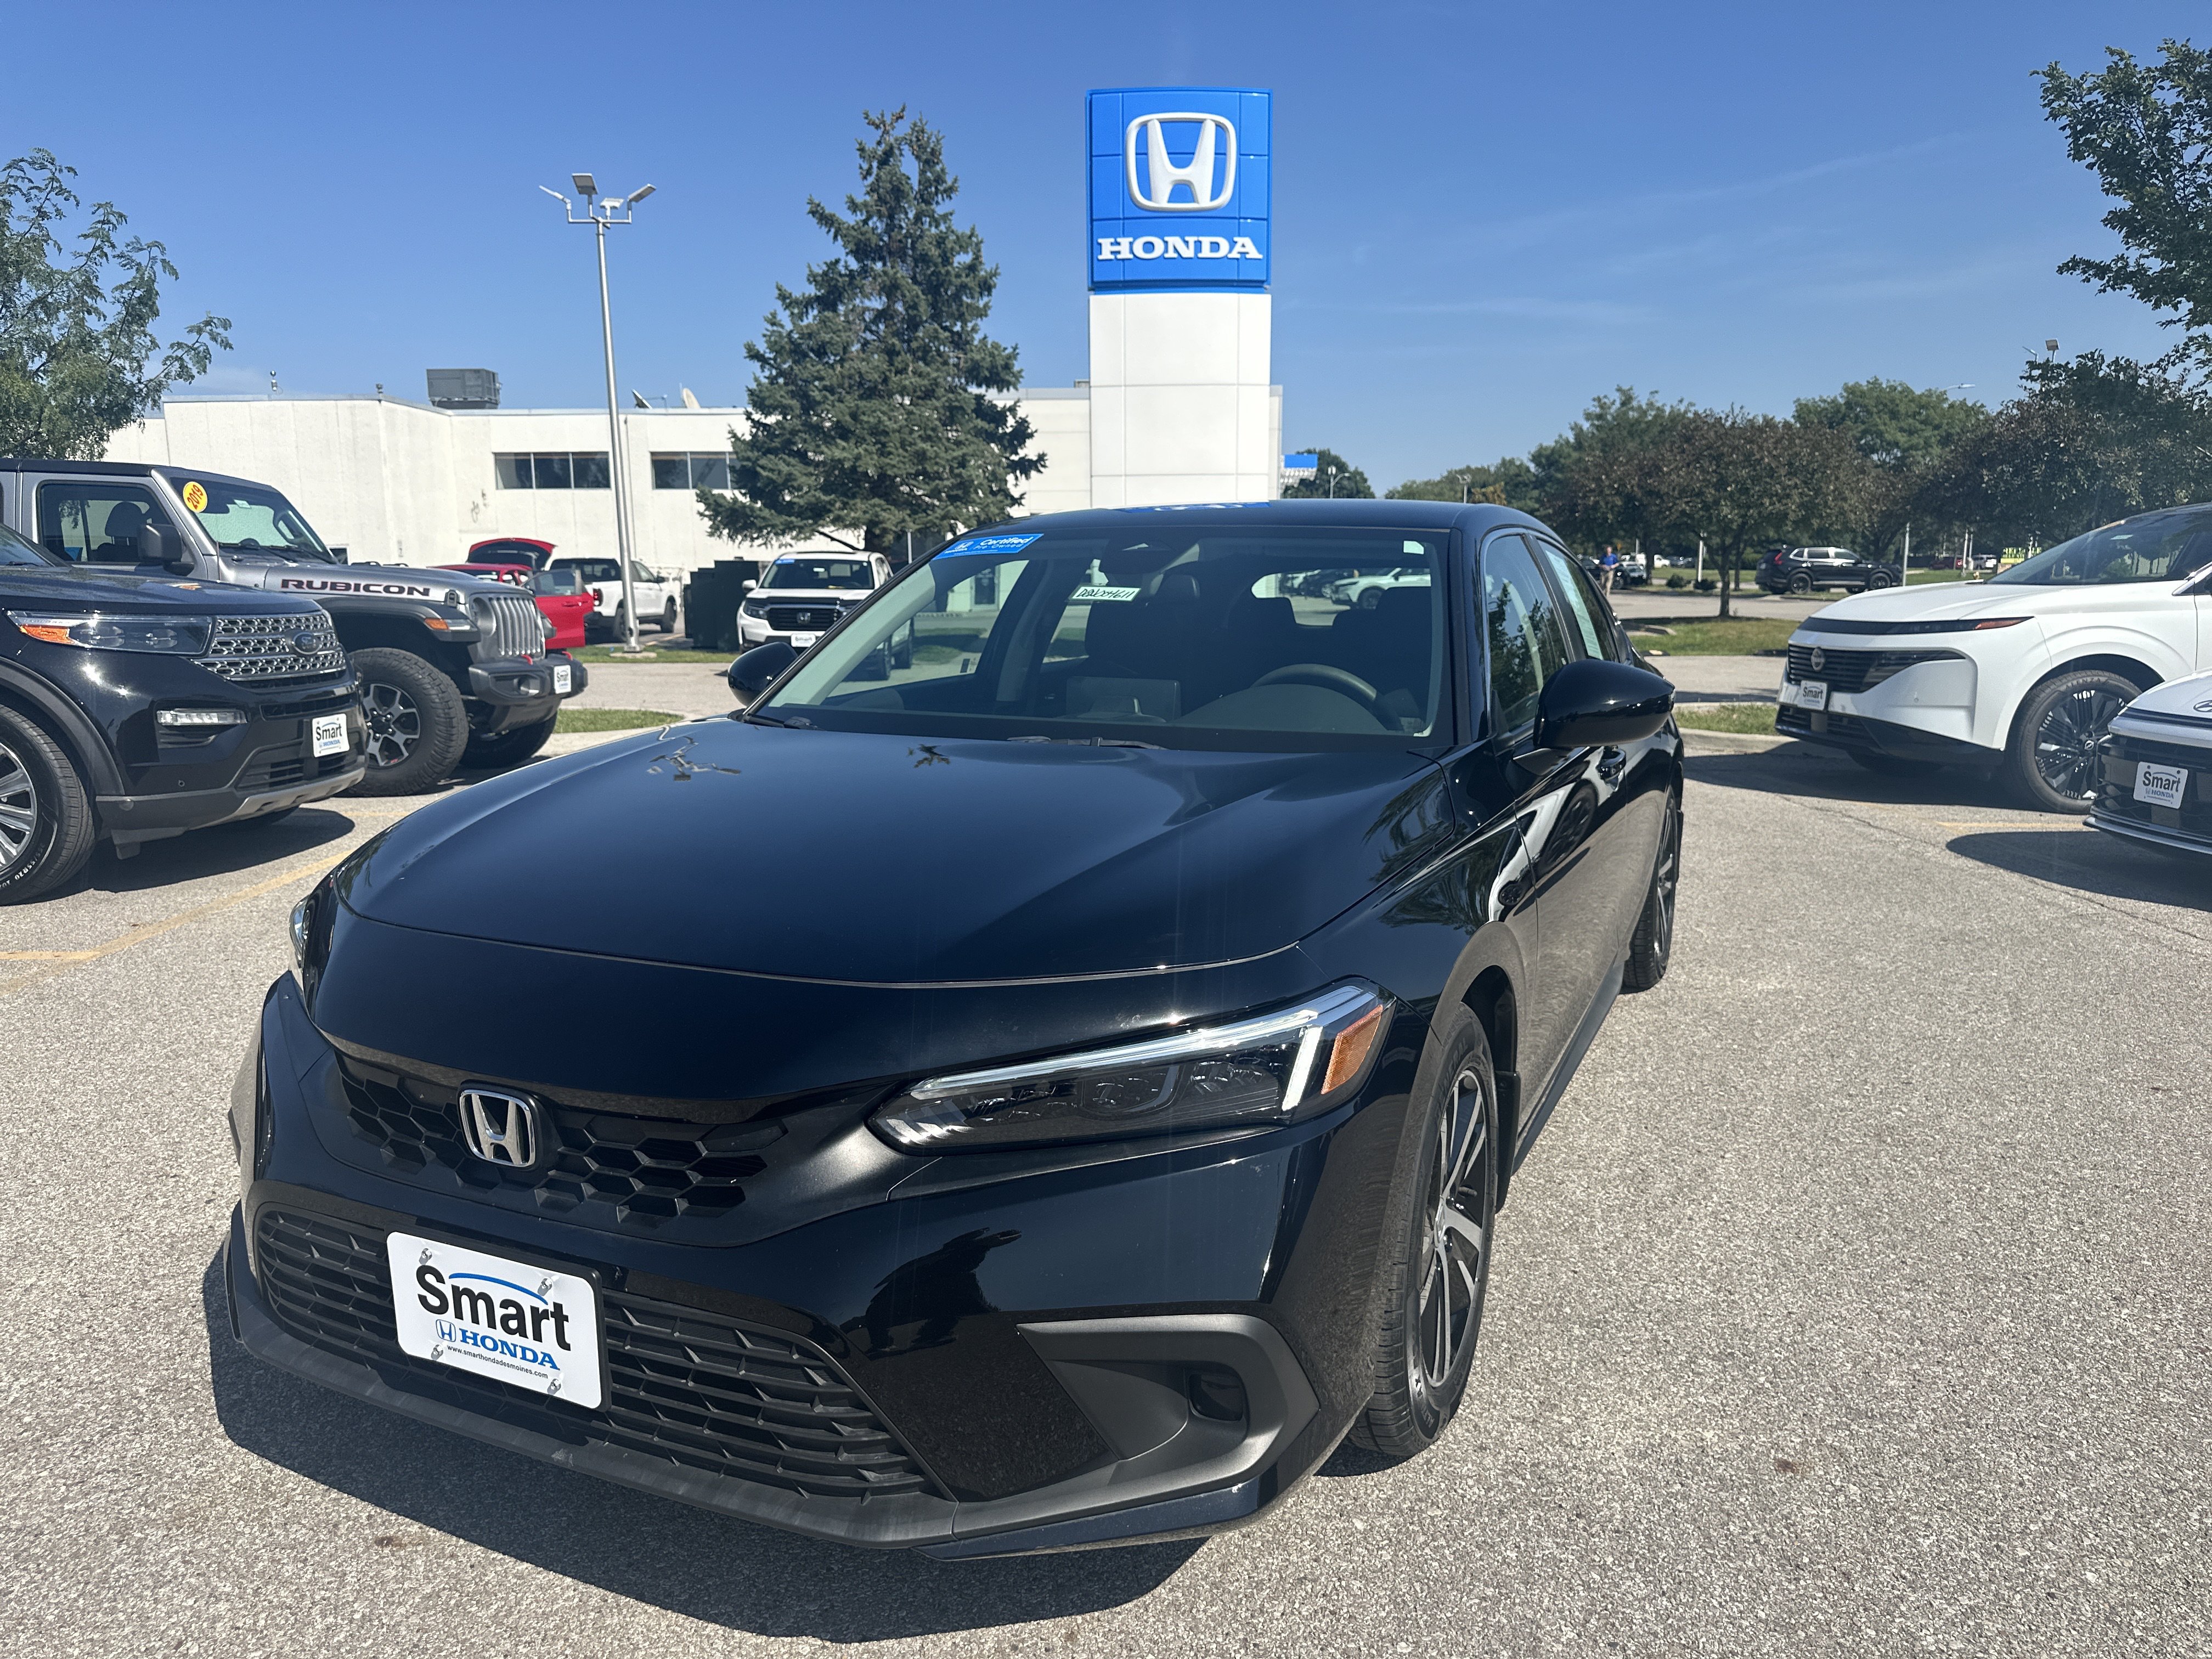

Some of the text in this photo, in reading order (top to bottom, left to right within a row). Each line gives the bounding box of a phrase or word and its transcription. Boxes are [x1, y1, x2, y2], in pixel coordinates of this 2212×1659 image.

[1097, 236, 1263, 259] HONDA
[187, 484, 204, 510] 2019
[980, 537, 1034, 545] Certified
[280, 579, 430, 596] RUBICON
[1803, 686, 1823, 699] Smart
[316, 724, 342, 741] Smart
[2142, 771, 2181, 792] Smart
[2152, 789, 2174, 799] HONDA
[416, 1265, 571, 1351] Smart
[459, 1328, 560, 1371] HONDA
[447, 1344, 548, 1379] www.smarthondadesmoines.com
